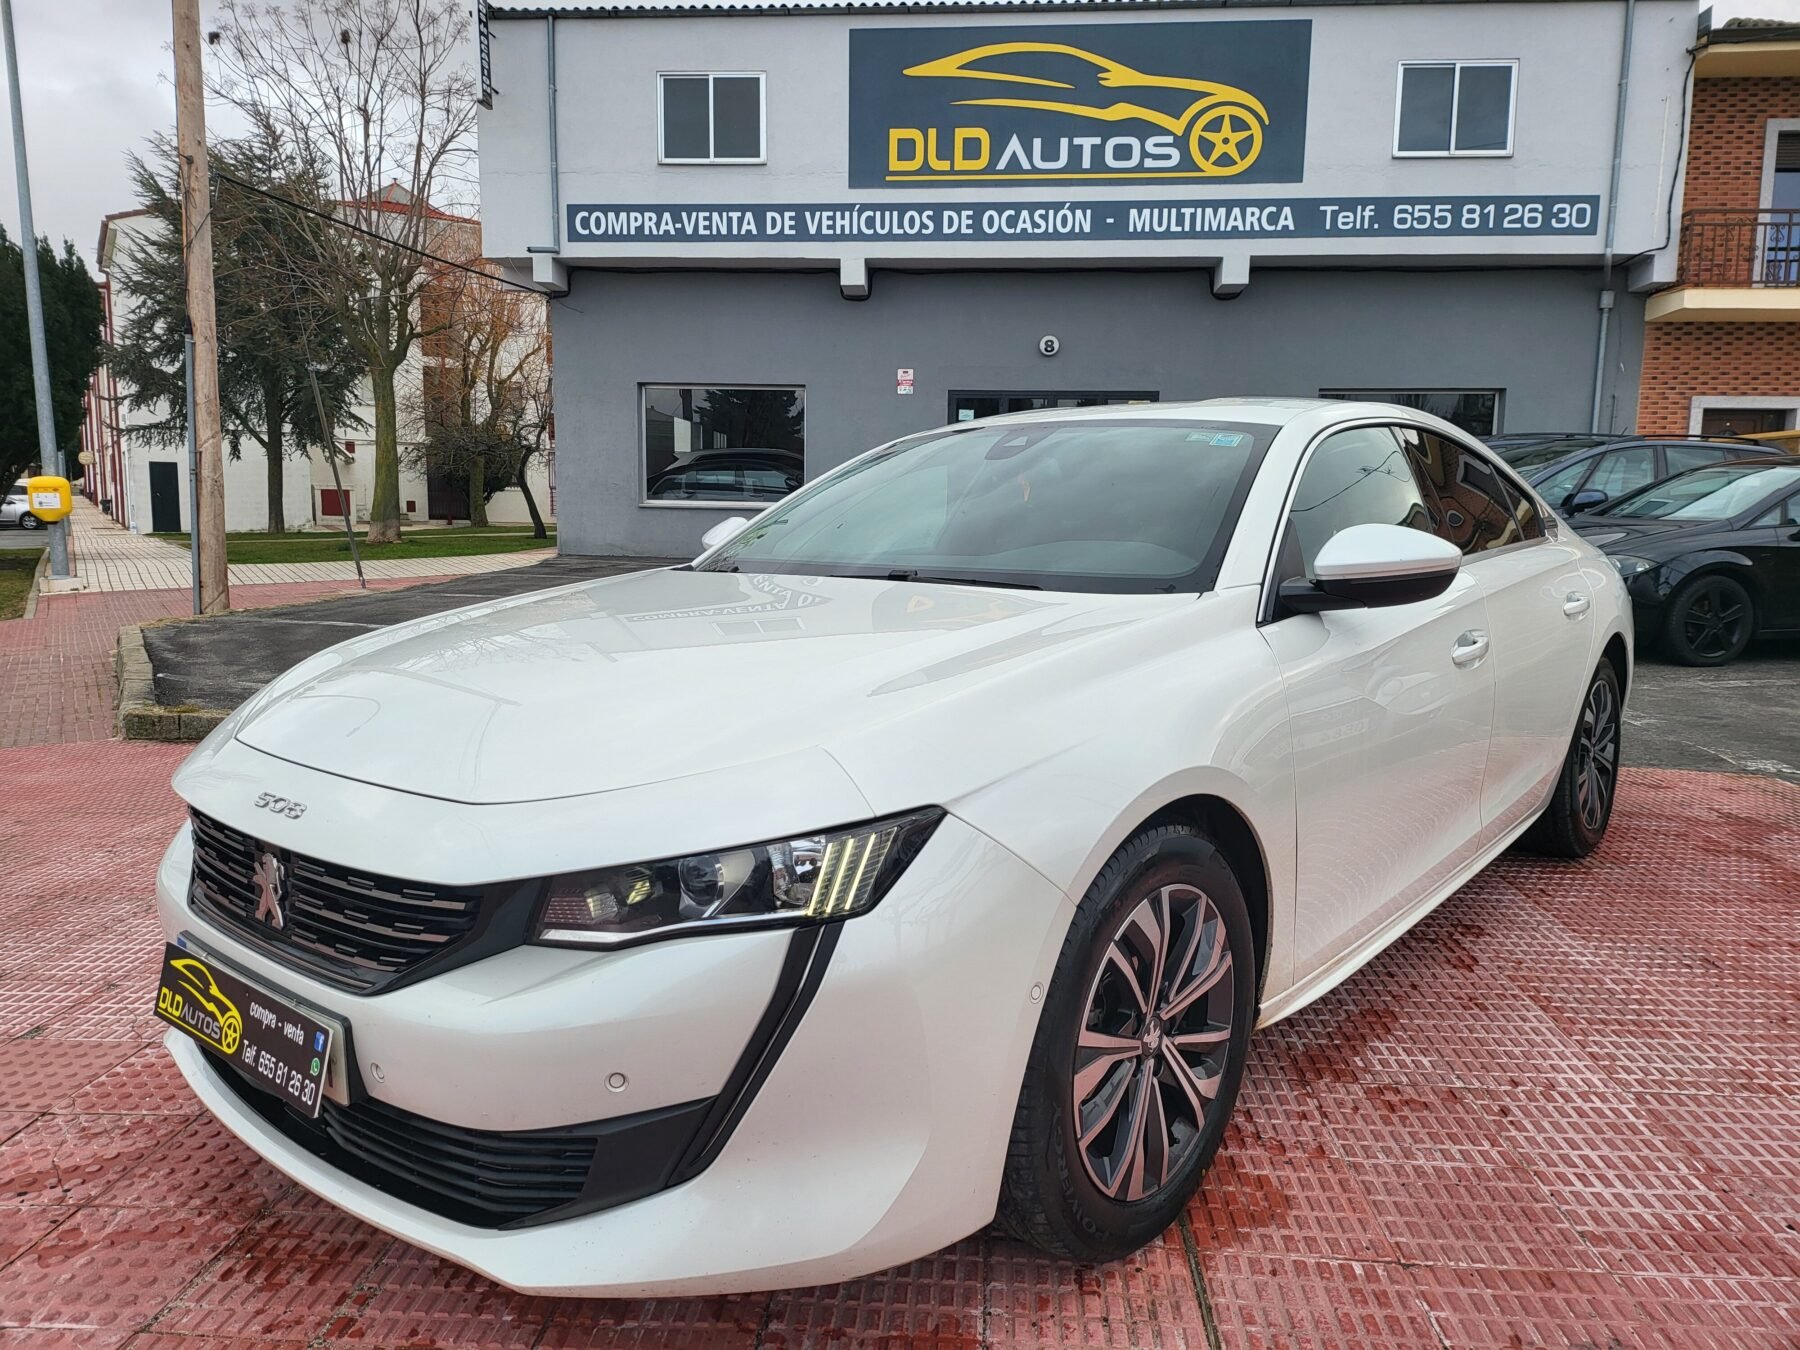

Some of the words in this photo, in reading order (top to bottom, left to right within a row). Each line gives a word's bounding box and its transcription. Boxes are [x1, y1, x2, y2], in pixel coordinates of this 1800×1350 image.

[889, 127, 991, 171] DLD
[995, 133, 1181, 170] AUTOS
[575, 211, 758, 235] COMPRA-VENTA
[766, 211, 796, 235] DE
[804, 204, 935, 235] VEHÍCULOS
[943, 210, 974, 234] DE
[982, 203, 1092, 234] OCASIÓN
[1128, 206, 1295, 232] MULTIMARCA
[1319, 205, 1379, 230] Telf.
[1393, 204, 1452, 229] 655
[1461, 204, 1496, 229] 81
[1503, 203, 1543, 228] 26
[1551, 203, 1591, 228] 30
[1044, 339, 1055, 353] 8
[254, 792, 307, 820] 508
[159, 986, 183, 1017] DLD
[180, 1002, 220, 1040] AUTOS
[250, 1002, 277, 1029] compra
[283, 1021, 305, 1046] venta
[242, 1039, 257, 1067] Telf.
[258, 1051, 276, 1079] 655
[275, 1062, 288, 1087] 81
[288, 1070, 302, 1097] 26
[301, 1079, 316, 1106] 30
